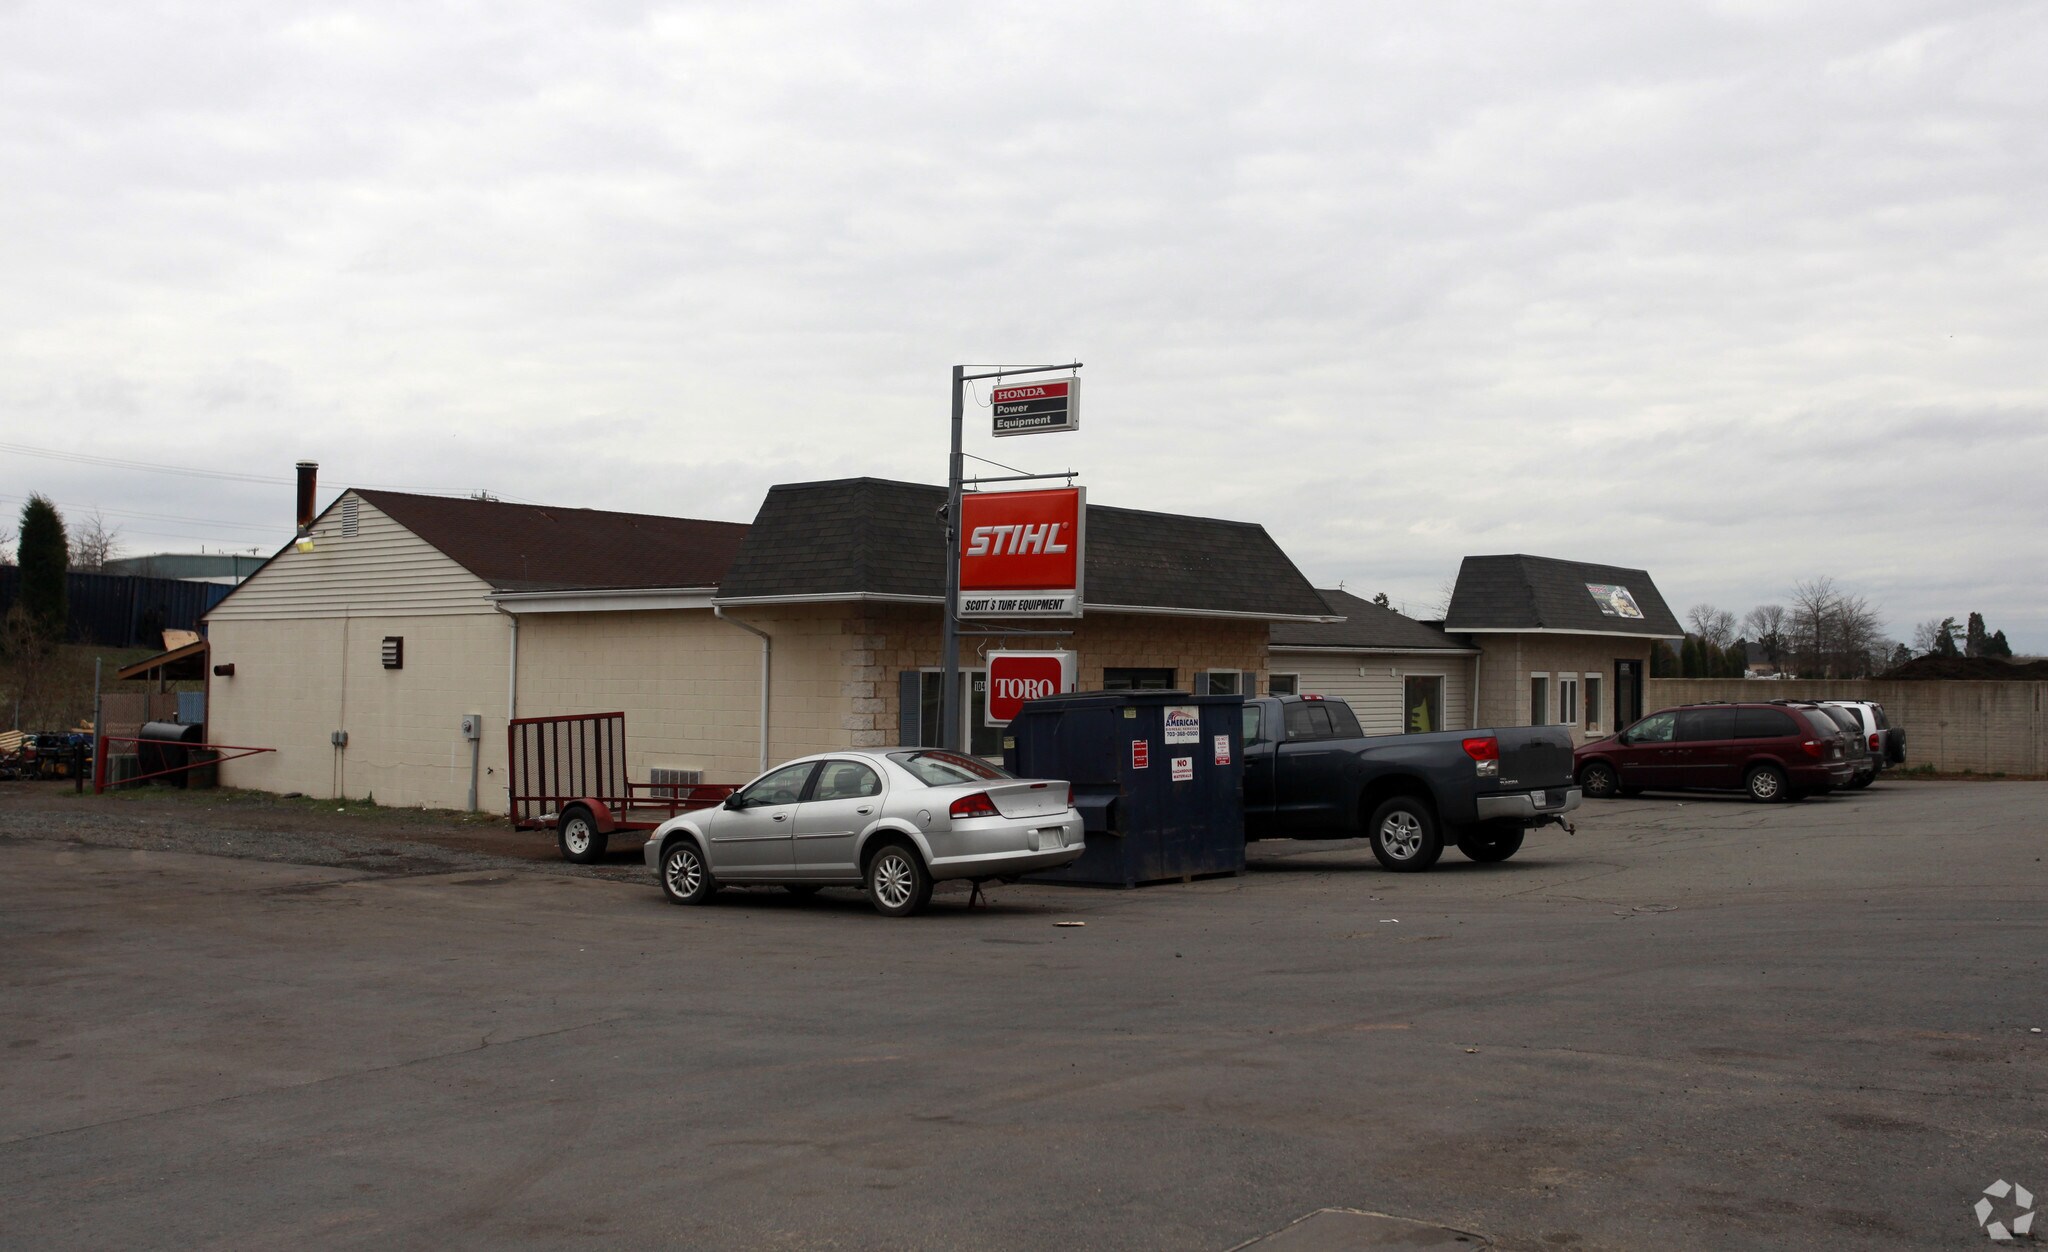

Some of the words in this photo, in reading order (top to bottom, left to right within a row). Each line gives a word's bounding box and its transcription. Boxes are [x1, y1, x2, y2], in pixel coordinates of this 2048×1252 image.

[998, 387, 1046, 400] HONDA
[997, 405, 1028, 414] Power
[997, 415, 1051, 428] Equipment
[966, 523, 1068, 556] STIHL
[965, 598, 996, 611] SCOTT'S
[998, 599, 1017, 611] TURF
[1018, 599, 1064, 611] EQUIPMENT
[995, 678, 1054, 699] TORO
[1177, 759, 1187, 767] NO
